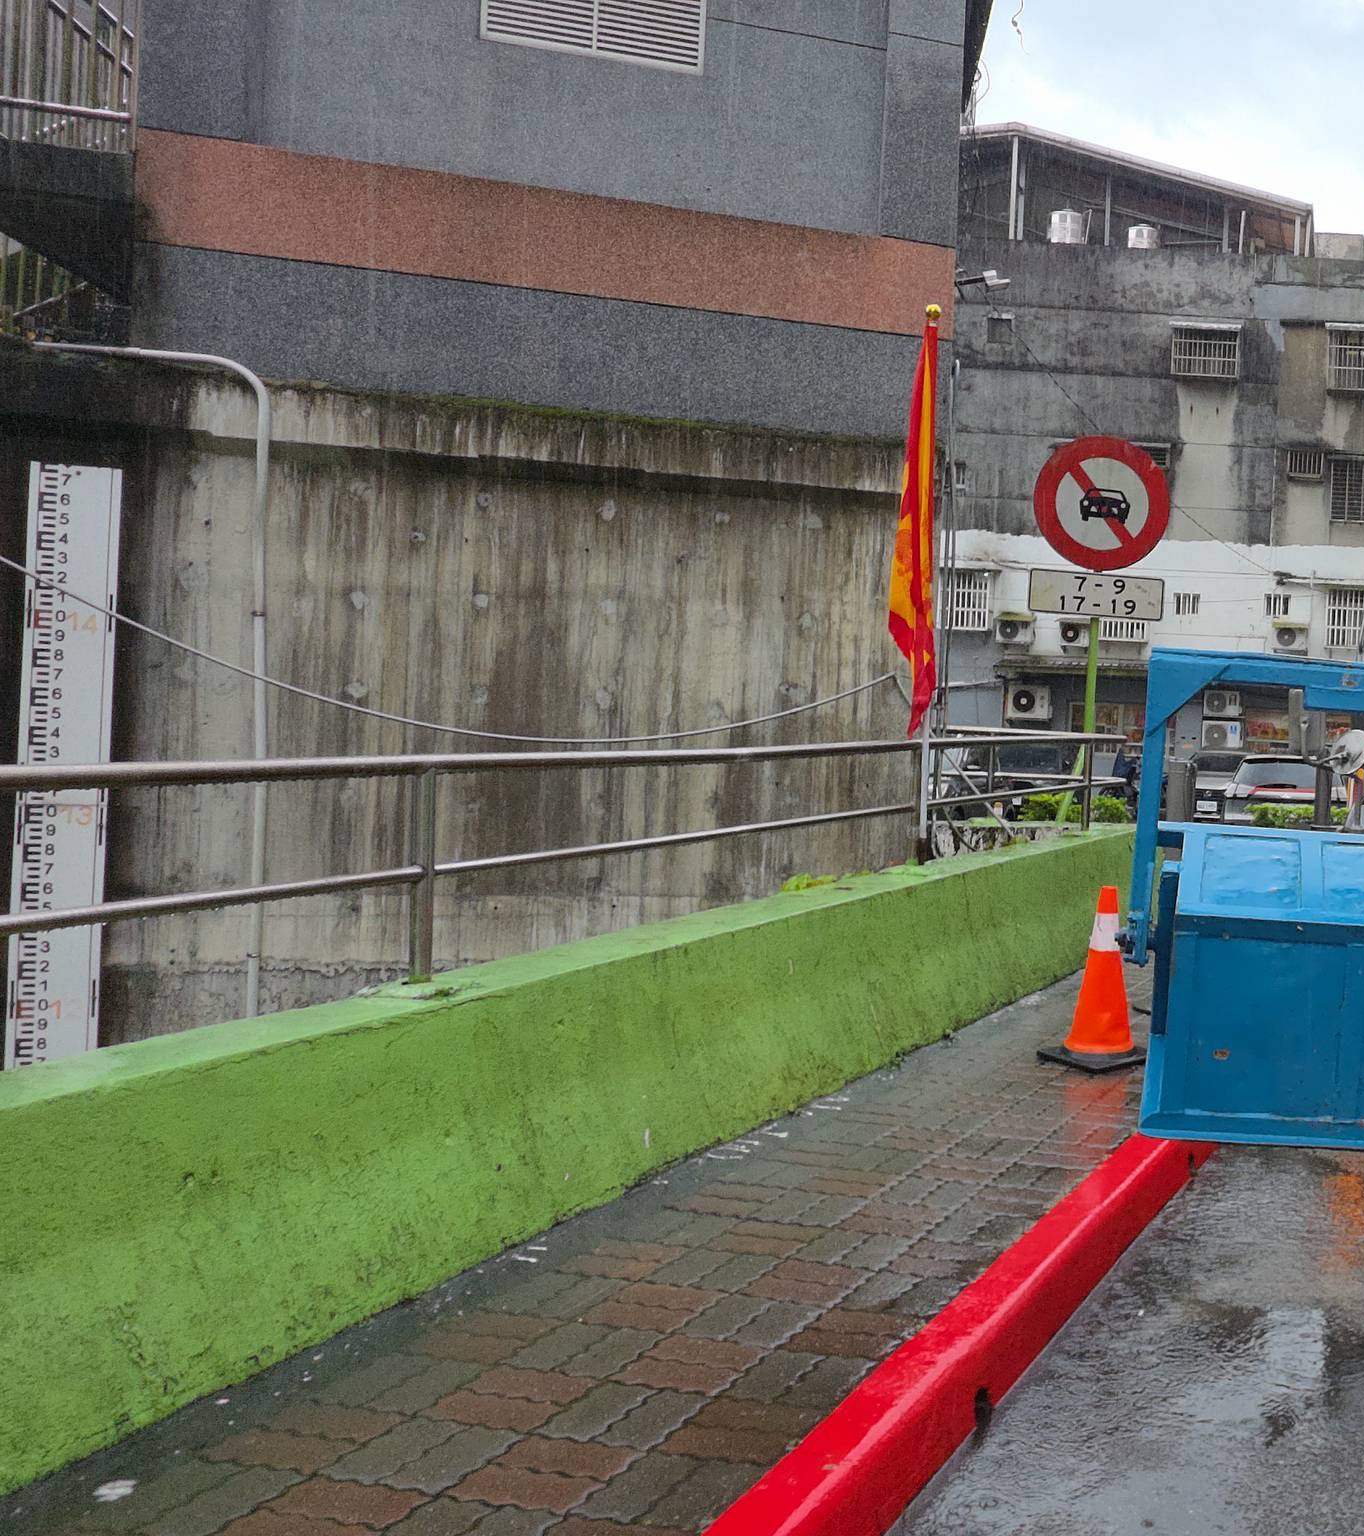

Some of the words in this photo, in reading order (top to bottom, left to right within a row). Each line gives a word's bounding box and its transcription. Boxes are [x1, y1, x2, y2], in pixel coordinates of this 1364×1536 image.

[62, 474, 72, 486] 7
[60, 494, 70, 505] 6
[60, 513, 69, 525] 5
[59, 533, 68, 544] 4
[58, 552, 67, 564] 3
[57, 572, 67, 584] 2
[56, 610, 66, 622] 0
[55, 630, 65, 641] 9
[54, 649, 64, 661] 8
[53, 668, 63, 680] 7
[52, 688, 62, 700] 6
[51, 707, 61, 719] 5
[50, 727, 60, 738] 4
[50, 746, 59, 758] 3
[46, 805, 56, 817] 0
[46, 824, 56, 836] 9
[45, 843, 55, 855] 8
[44, 863, 54, 875] 7
[43, 882, 53, 894] 6
[40, 941, 50, 953] 3
[40, 960, 49, 972] 2
[40, 980, 48, 991] 1
[38, 999, 48, 1011] 0
[38, 1018, 48, 1030] 9
[37, 1038, 47, 1050] 8
